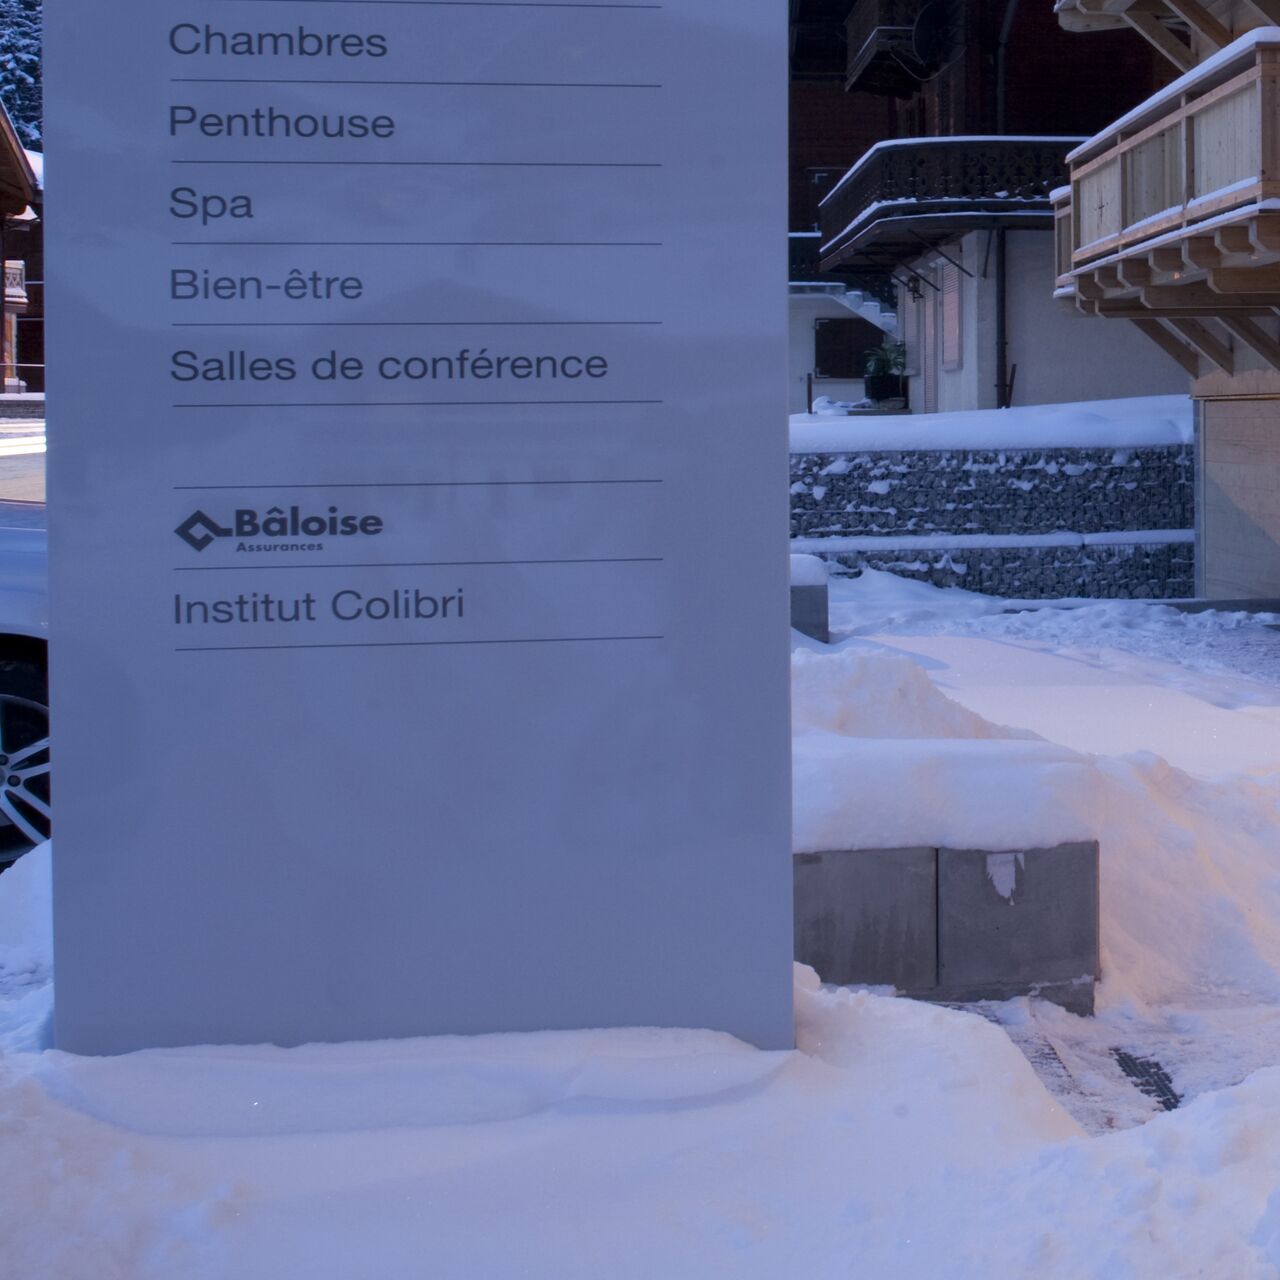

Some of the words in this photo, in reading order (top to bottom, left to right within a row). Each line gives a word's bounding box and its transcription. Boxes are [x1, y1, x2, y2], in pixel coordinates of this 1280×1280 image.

[169, 23, 388, 58] Chambres
[170, 105, 395, 138] Penthouse
[169, 186, 254, 226] Spa
[170, 268, 363, 300] Bien-être
[170, 350, 297, 382] Salles
[311, 349, 364, 381] de
[378, 348, 608, 380] conférence
[235, 505, 384, 537] Bâloise
[236, 541, 324, 553] Assurances
[174, 592, 316, 625] Institut
[331, 588, 464, 621] Colibri
